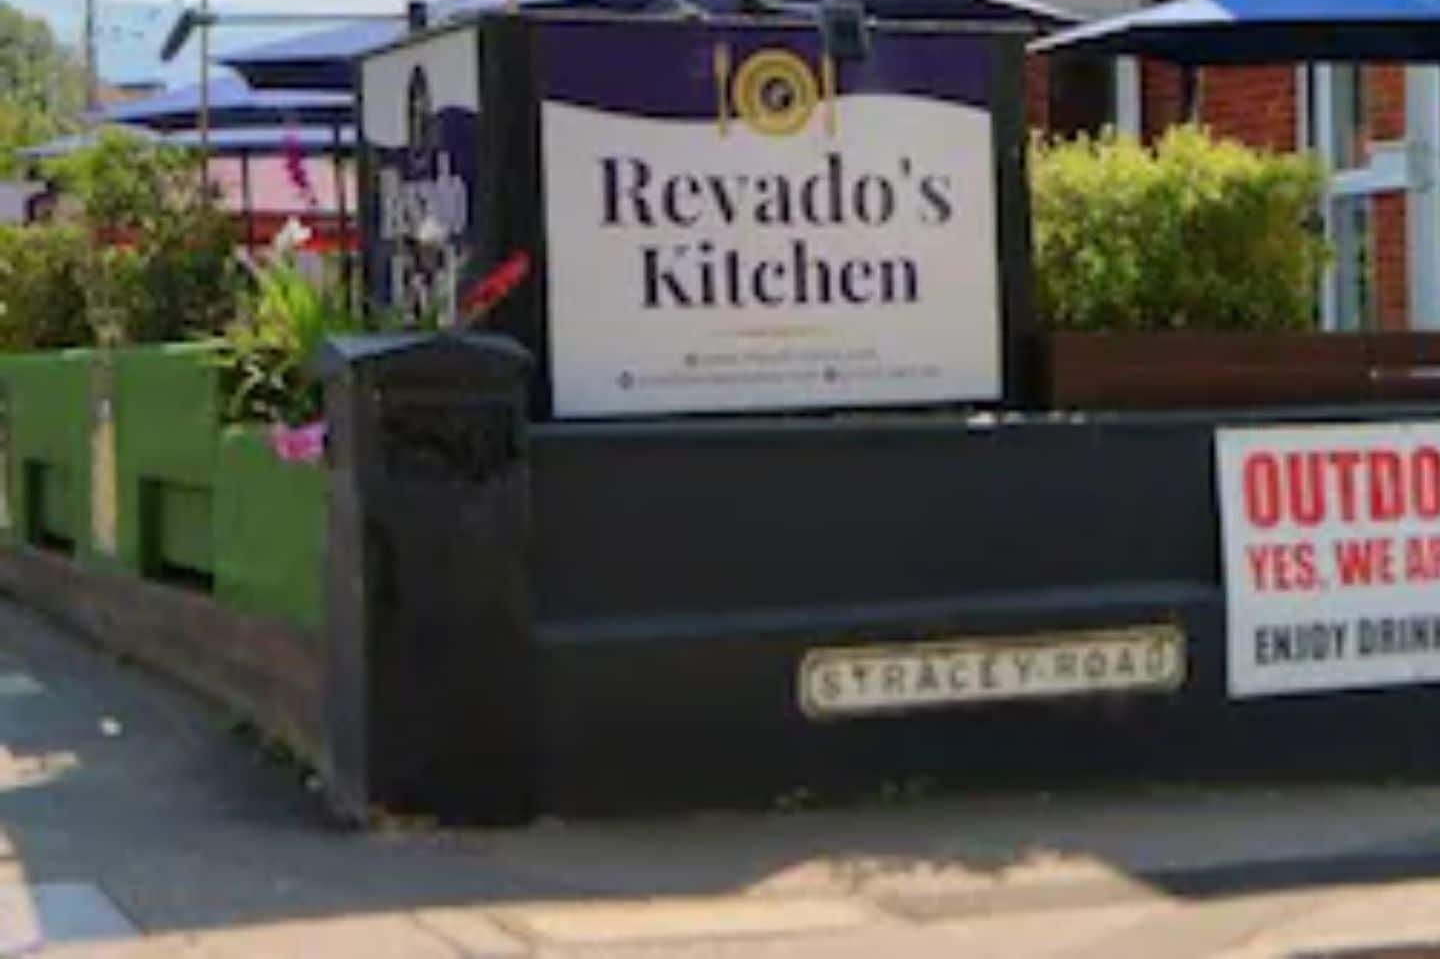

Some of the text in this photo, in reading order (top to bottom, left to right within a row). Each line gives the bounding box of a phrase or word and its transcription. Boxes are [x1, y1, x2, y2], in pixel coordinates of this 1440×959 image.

[599, 150, 954, 226] Revado's
[640, 240, 919, 308] Kitchen
[1334, 540, 1395, 586] WE
[1254, 619, 1347, 665] ENJOY
[818, 652, 1038, 701] STRACEY
